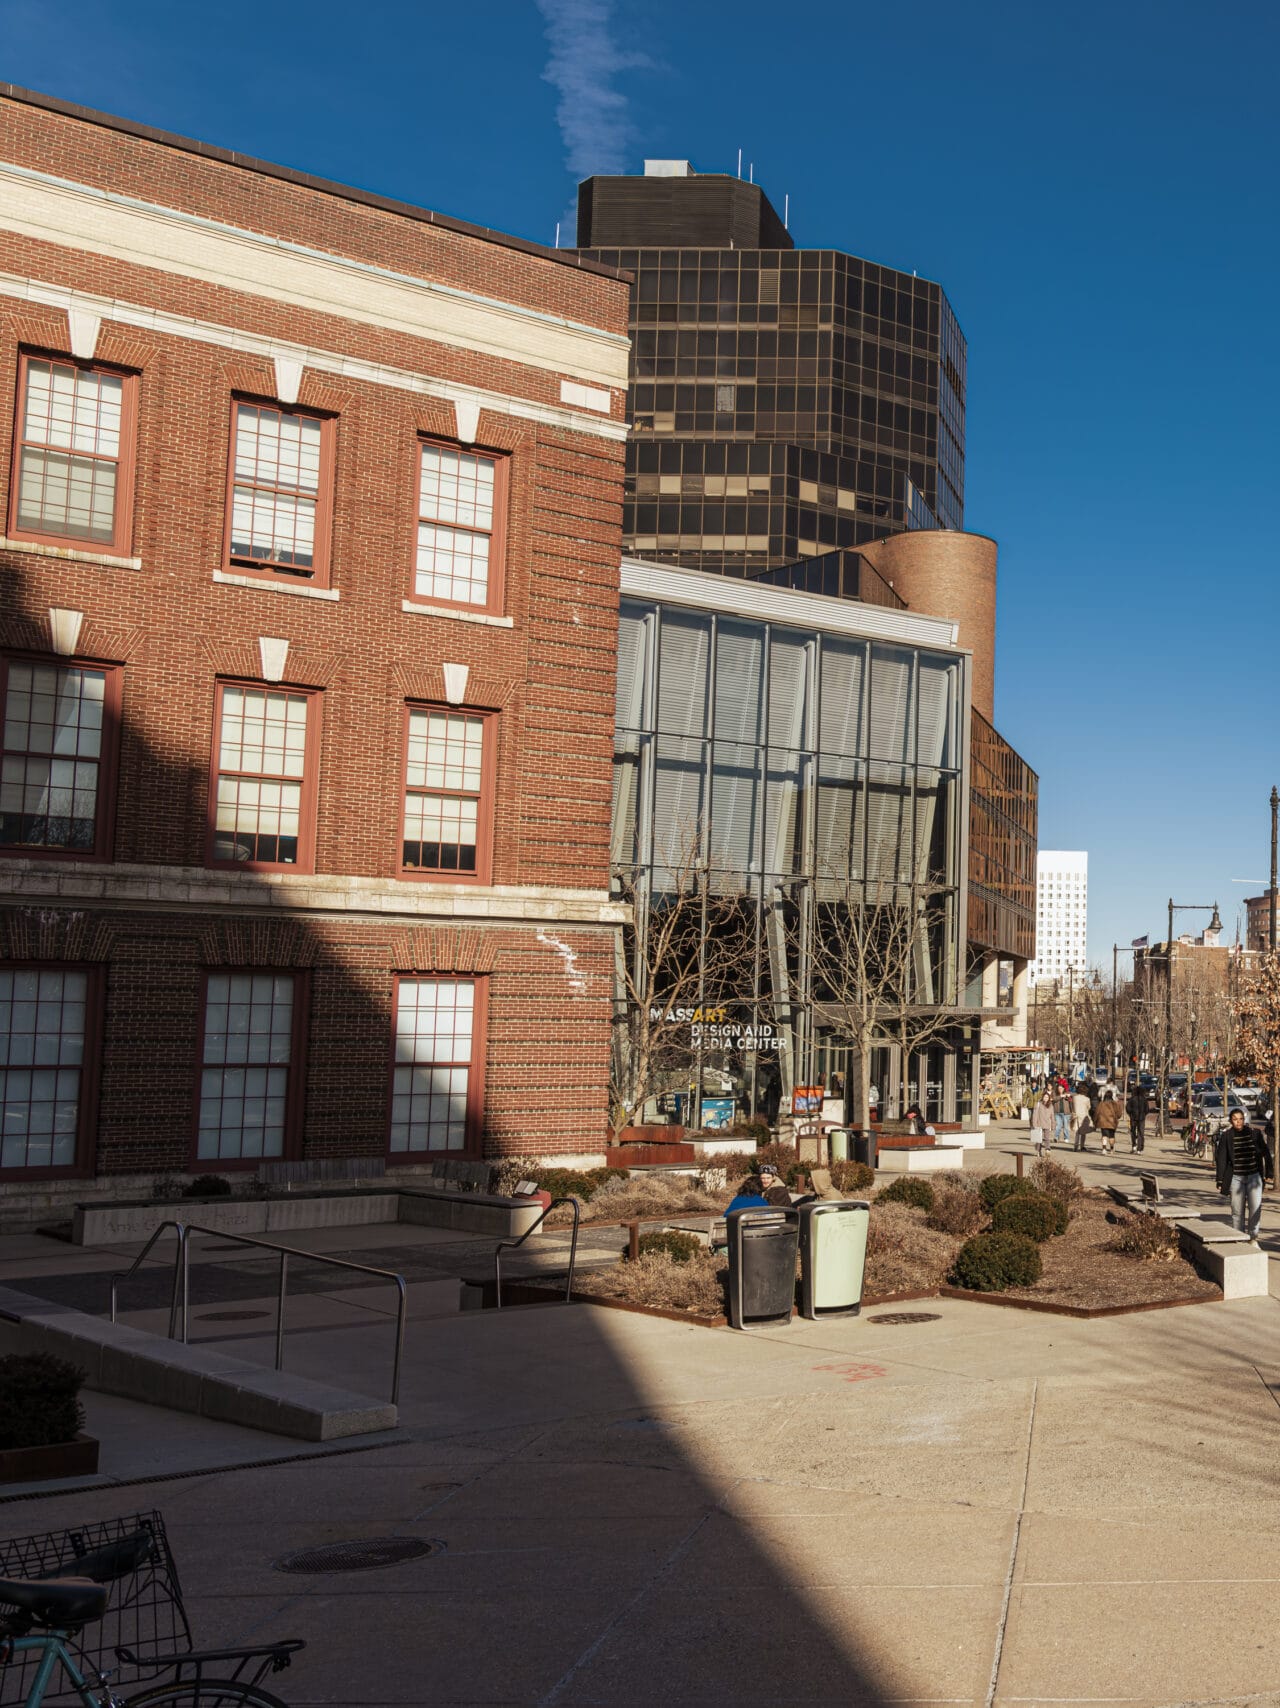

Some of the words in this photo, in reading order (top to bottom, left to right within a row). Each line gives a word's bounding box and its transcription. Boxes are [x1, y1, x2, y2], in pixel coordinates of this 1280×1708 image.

[650, 1008, 727, 1022] MASSART
[691, 1025, 741, 1037] DESIGN
[745, 1025, 772, 1037] AND
[691, 1038, 733, 1050] MEDIA
[737, 1038, 788, 1050] CENTER
